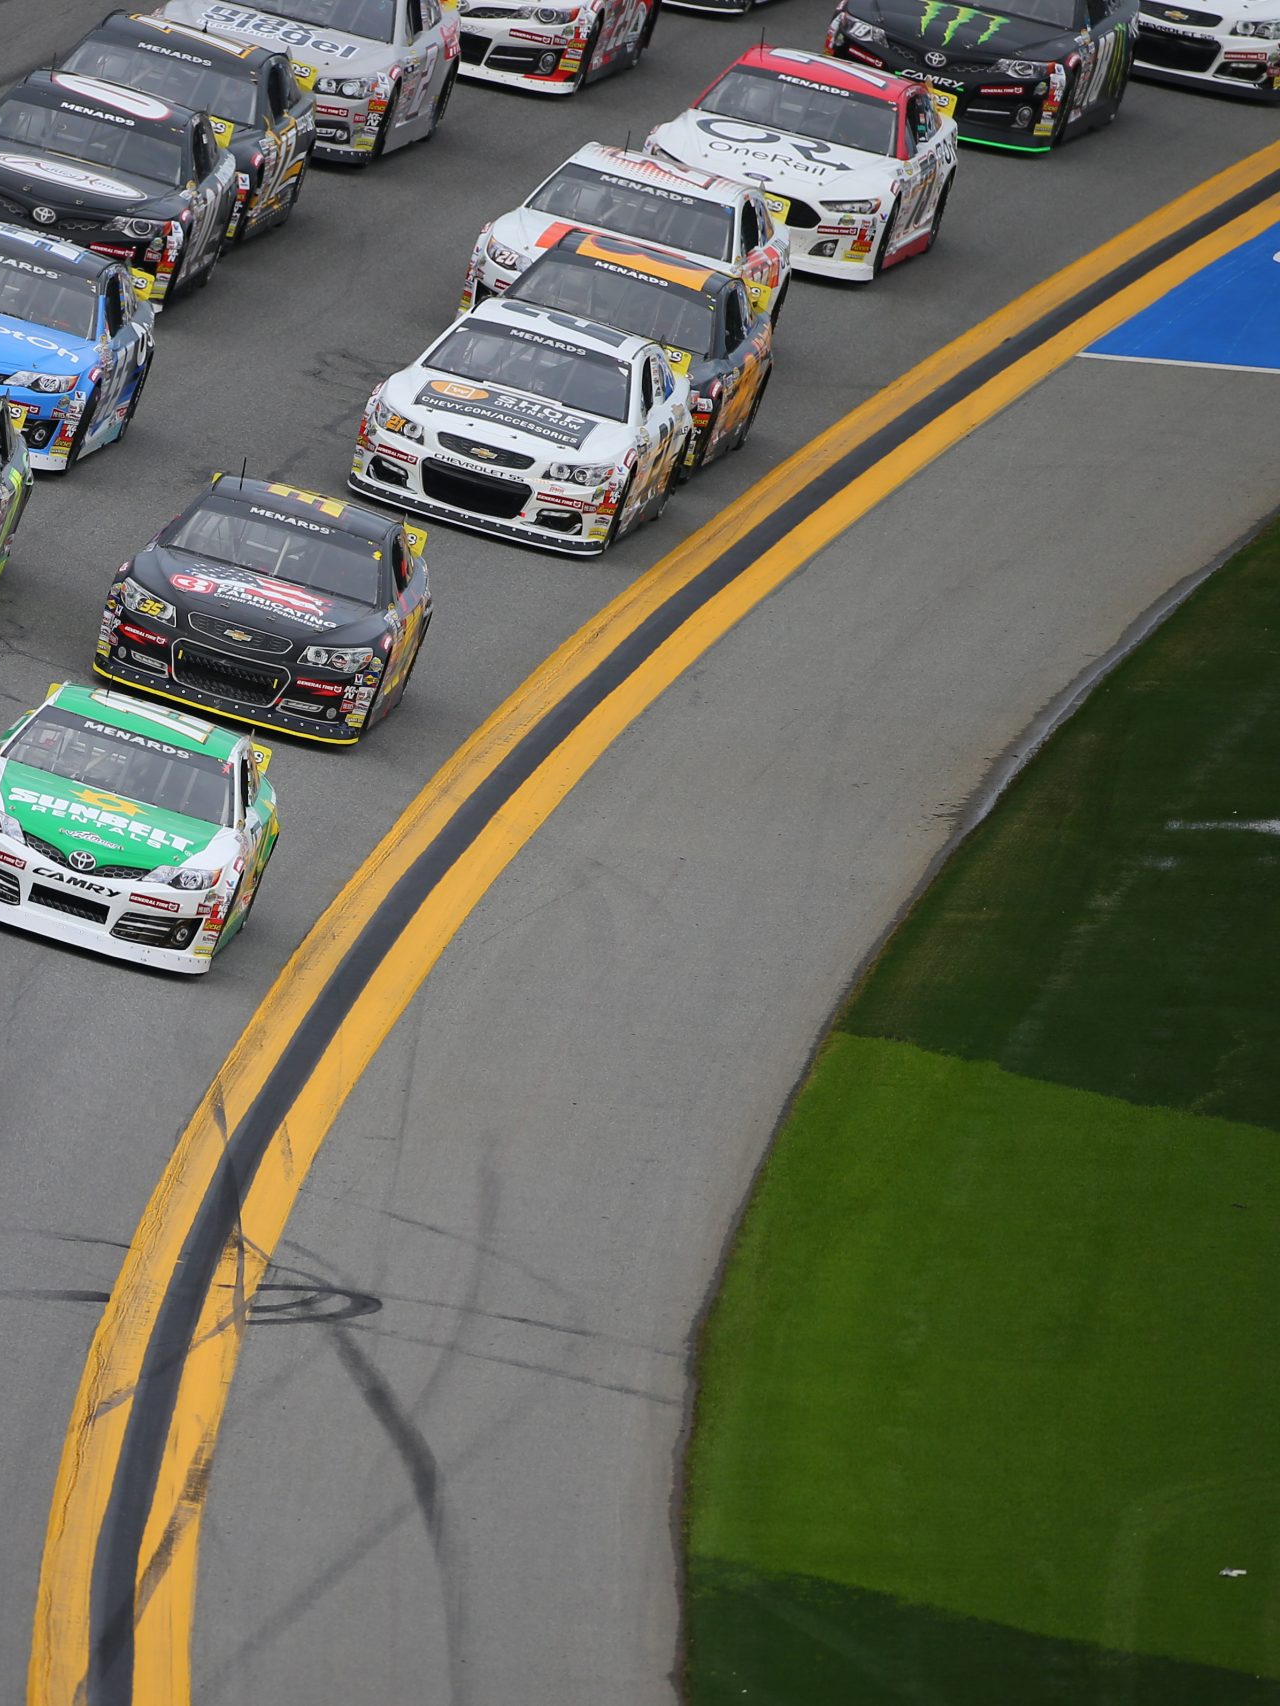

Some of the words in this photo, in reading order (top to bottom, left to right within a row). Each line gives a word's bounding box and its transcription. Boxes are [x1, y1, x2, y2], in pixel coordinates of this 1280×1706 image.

[849, 22, 871, 37] 18
[138, 42, 212, 66] MENARDS
[778, 73, 850, 97] MENARDS
[901, 69, 964, 88] CAMRY
[60, 102, 136, 126] MENARDS
[709, 142, 826, 176] OneRail
[600, 175, 694, 204] MENARDS
[496, 250, 519, 266] 20
[595, 261, 668, 287] MENARDS
[510, 329, 586, 356] MENARDS
[385, 415, 407, 432] 21
[421, 395, 578, 443] CHEVY.COM/ACCESSORIES
[494, 400, 545, 419] ONLINE
[547, 415, 581, 430] NOW
[497, 394, 586, 424] SHOP
[434, 453, 505, 477] CHEVROLET
[509, 474, 524, 482] SS
[249, 507, 330, 535] MENARDS
[139, 599, 164, 617] 35
[213, 592, 246, 604] Custom
[247, 600, 273, 612] Metal
[274, 607, 320, 628] Fabricators
[217, 588, 337, 628] FABRICATING
[84, 720, 190, 759] MENARDS
[8, 787, 194, 852] SUNBELT
[31, 805, 161, 848] RENTALS
[32, 867, 122, 898] CAMRY
